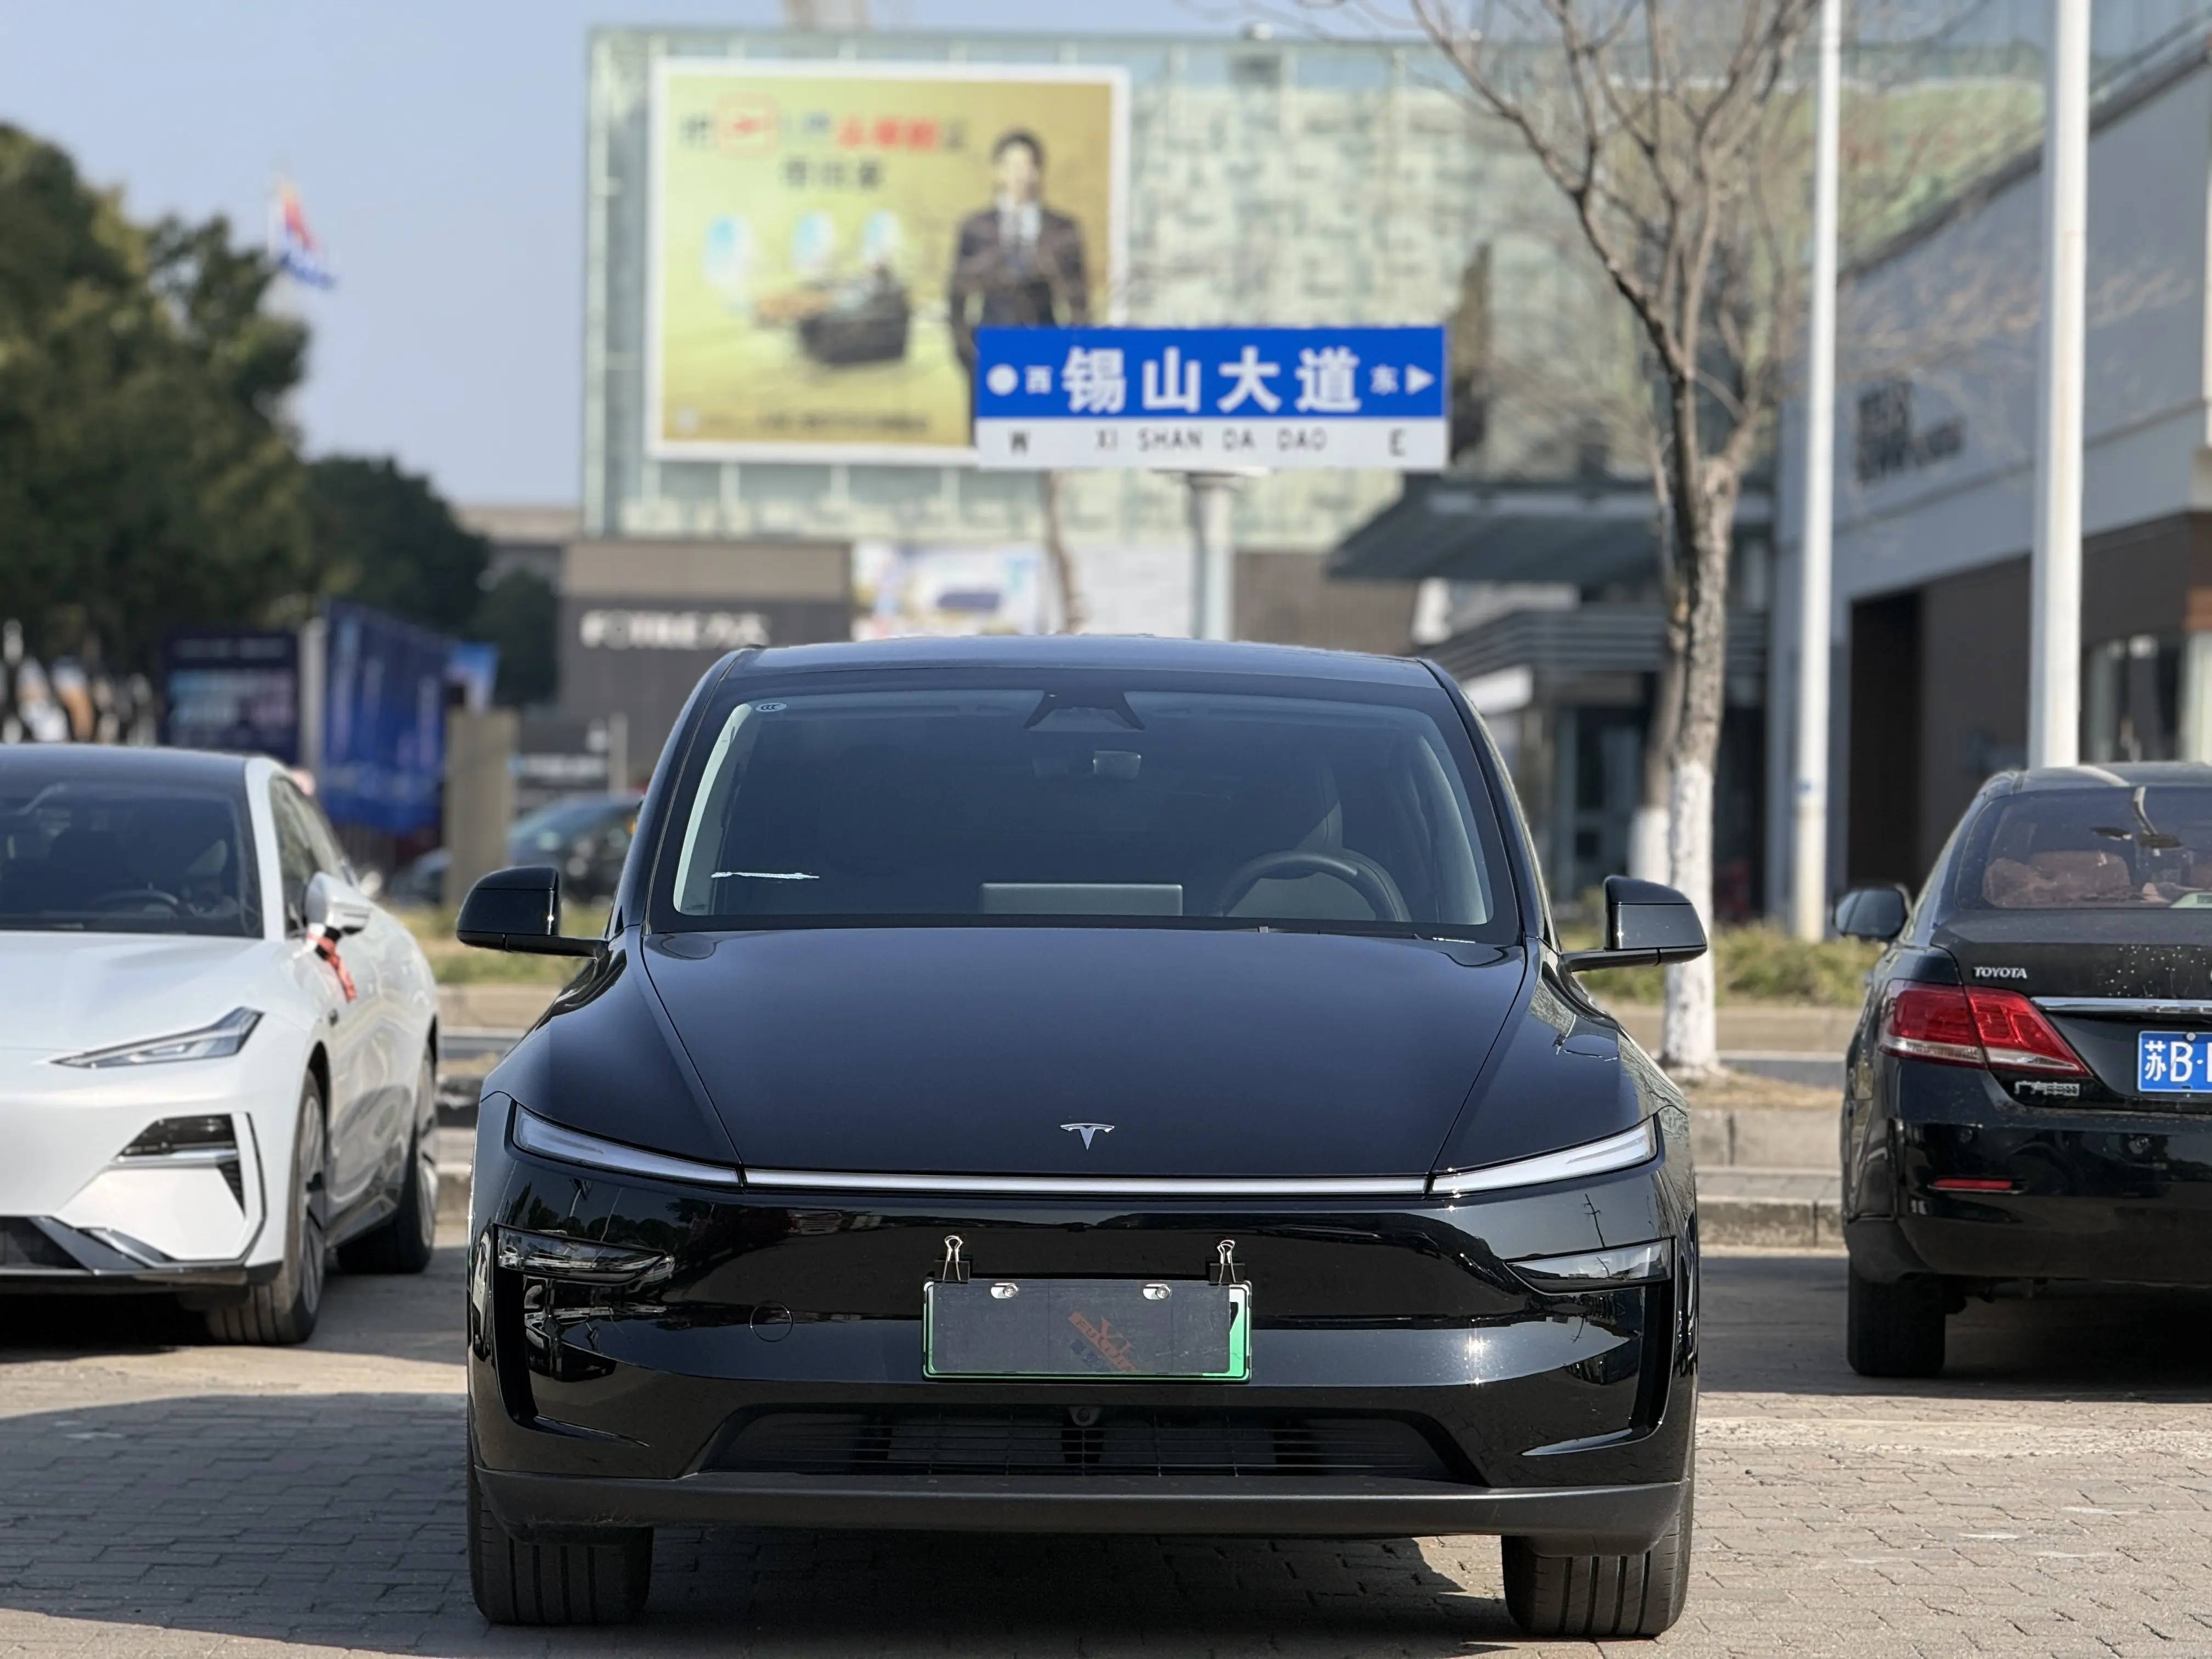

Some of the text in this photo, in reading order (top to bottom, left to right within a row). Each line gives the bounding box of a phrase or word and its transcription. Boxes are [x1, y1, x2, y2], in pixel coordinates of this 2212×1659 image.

[1060, 345, 1363, 414] 锡山大道
[1007, 428, 1030, 456] W
[1096, 427, 1118, 452] XI
[1137, 426, 1204, 453] SHAN
[1222, 426, 1256, 452] DA
[1276, 425, 1328, 452] DAO
[1973, 967, 2028, 979] TOYOTA
